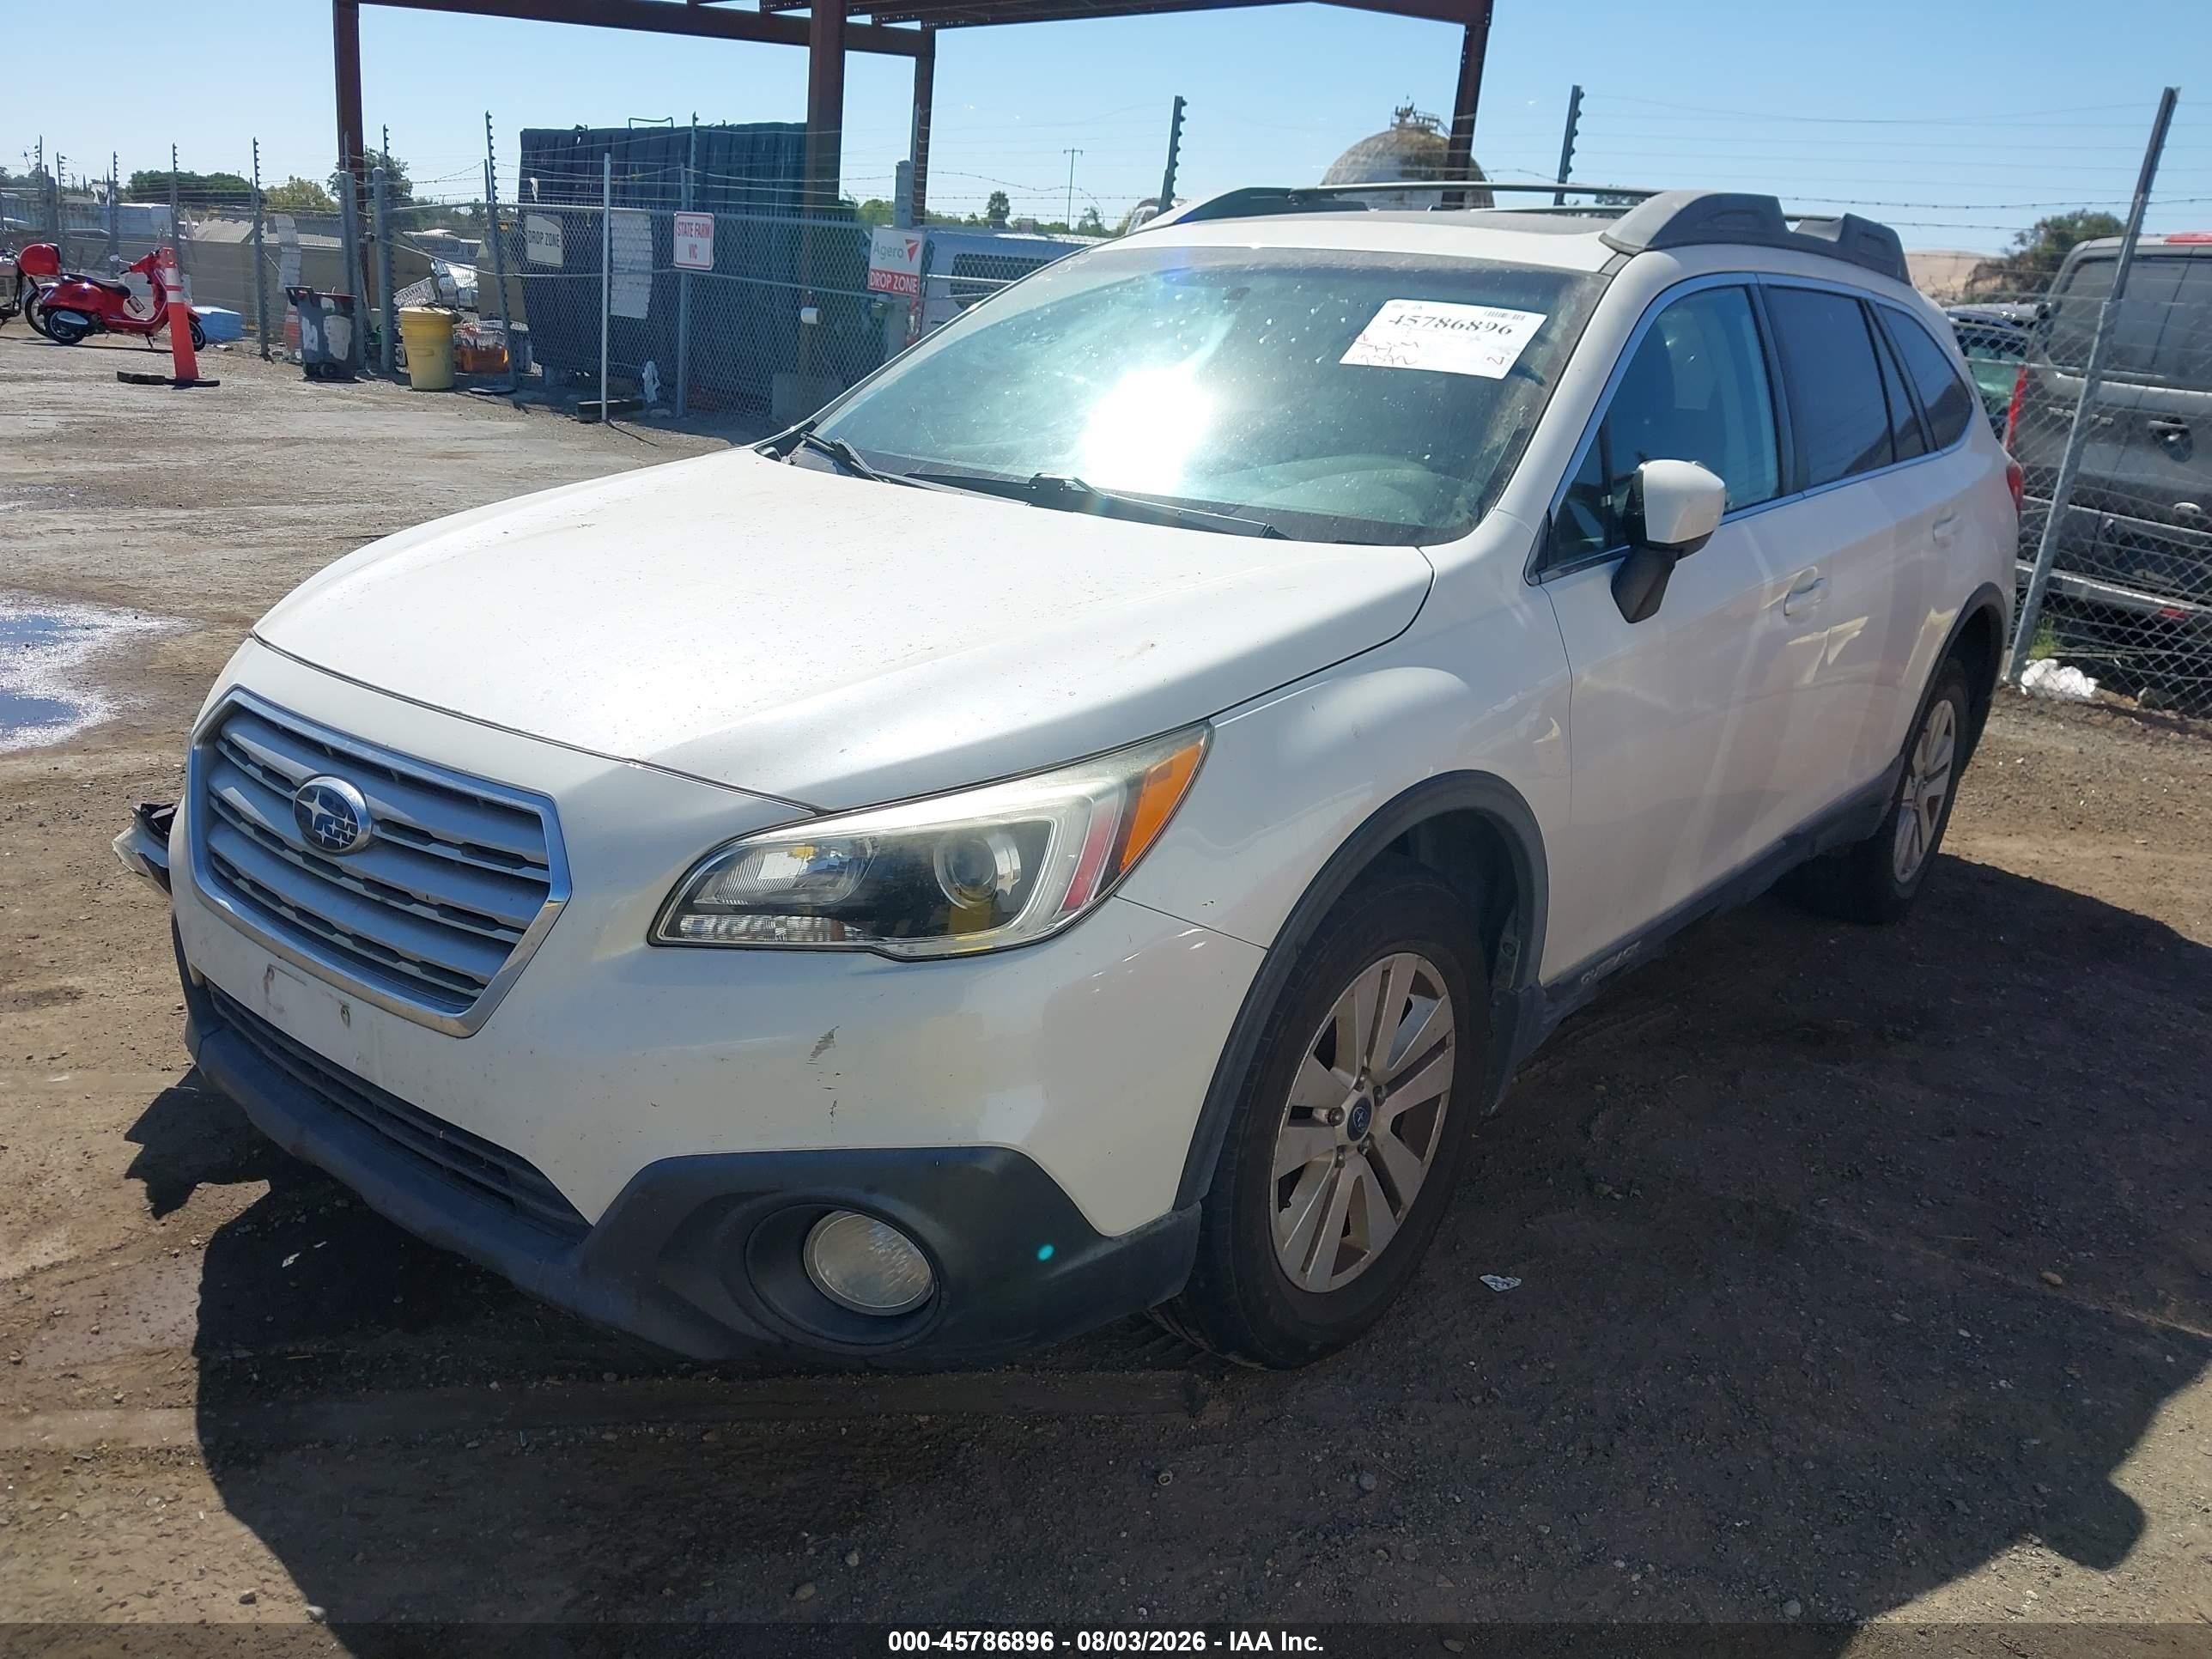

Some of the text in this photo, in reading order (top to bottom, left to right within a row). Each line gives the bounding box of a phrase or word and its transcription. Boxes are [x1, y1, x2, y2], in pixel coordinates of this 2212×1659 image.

[528, 229, 560, 248] DROP ZONE
[678, 221, 711, 239] STATE FARM
[873, 240, 904, 261] Agero
[870, 270, 919, 294] DROP ZONE
[1389, 313, 1513, 336] 45786896
